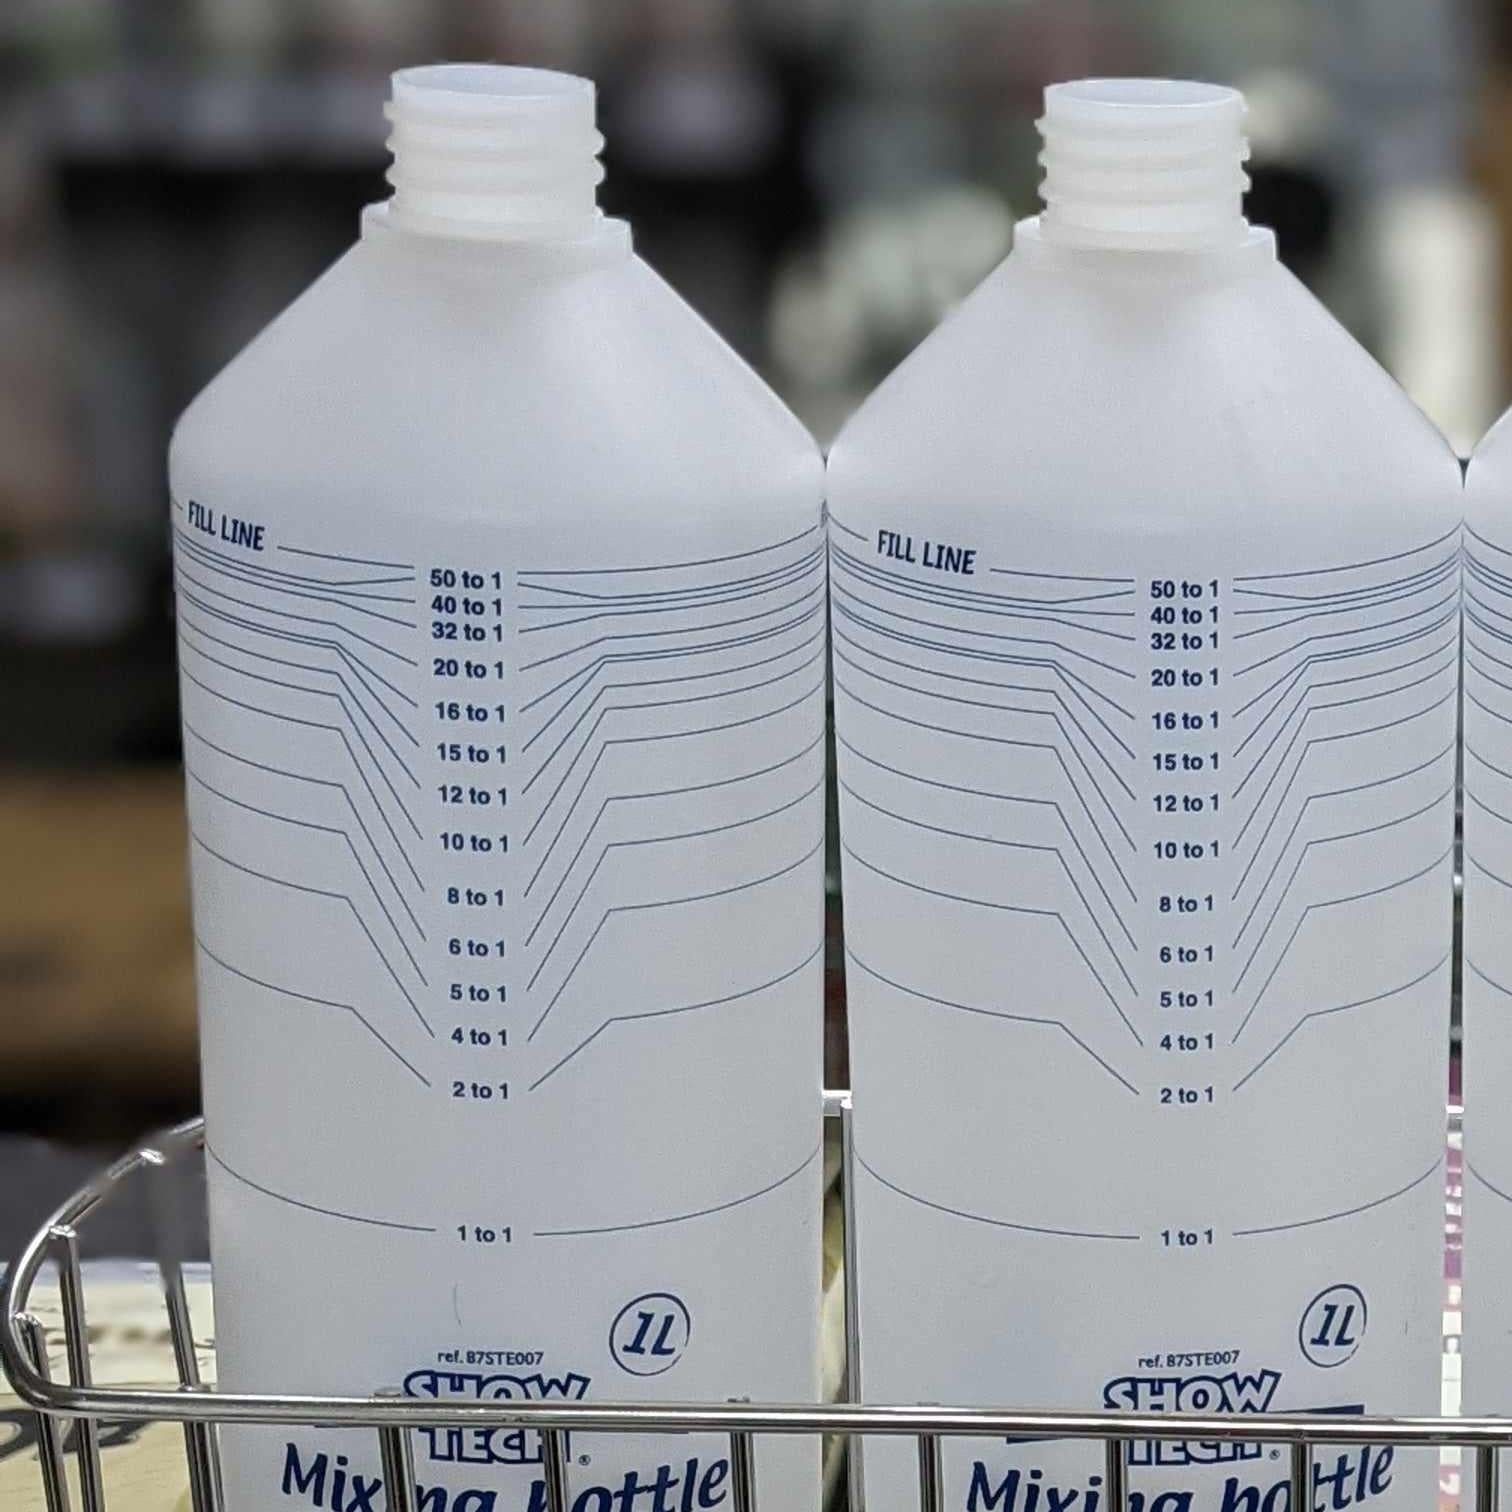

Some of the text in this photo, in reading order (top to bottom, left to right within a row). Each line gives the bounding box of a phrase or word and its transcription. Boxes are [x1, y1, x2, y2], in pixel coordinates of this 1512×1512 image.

[187, 501, 264, 552] FILL LINE
[877, 529, 976, 576] FILL LINE
[429, 567, 501, 591] 50 to 1
[1150, 631, 1219, 651] 32 to 1
[432, 657, 504, 680] 20 to 1
[1152, 751, 1219, 772] 15 to 1
[437, 784, 507, 807] 12 to 1
[1153, 839, 1219, 860] 10 to 1
[450, 1026, 508, 1047] 4 to 1
[1159, 1085, 1214, 1105] 2 to 1
[622, 1311, 677, 1357] 1L
[1310, 1303, 1356, 1347] 1L
[437, 1350, 464, 1366] ref.
[1138, 1350, 1240, 1369] ref. 87STE007
[1104, 1369, 1281, 1412] SHOW
